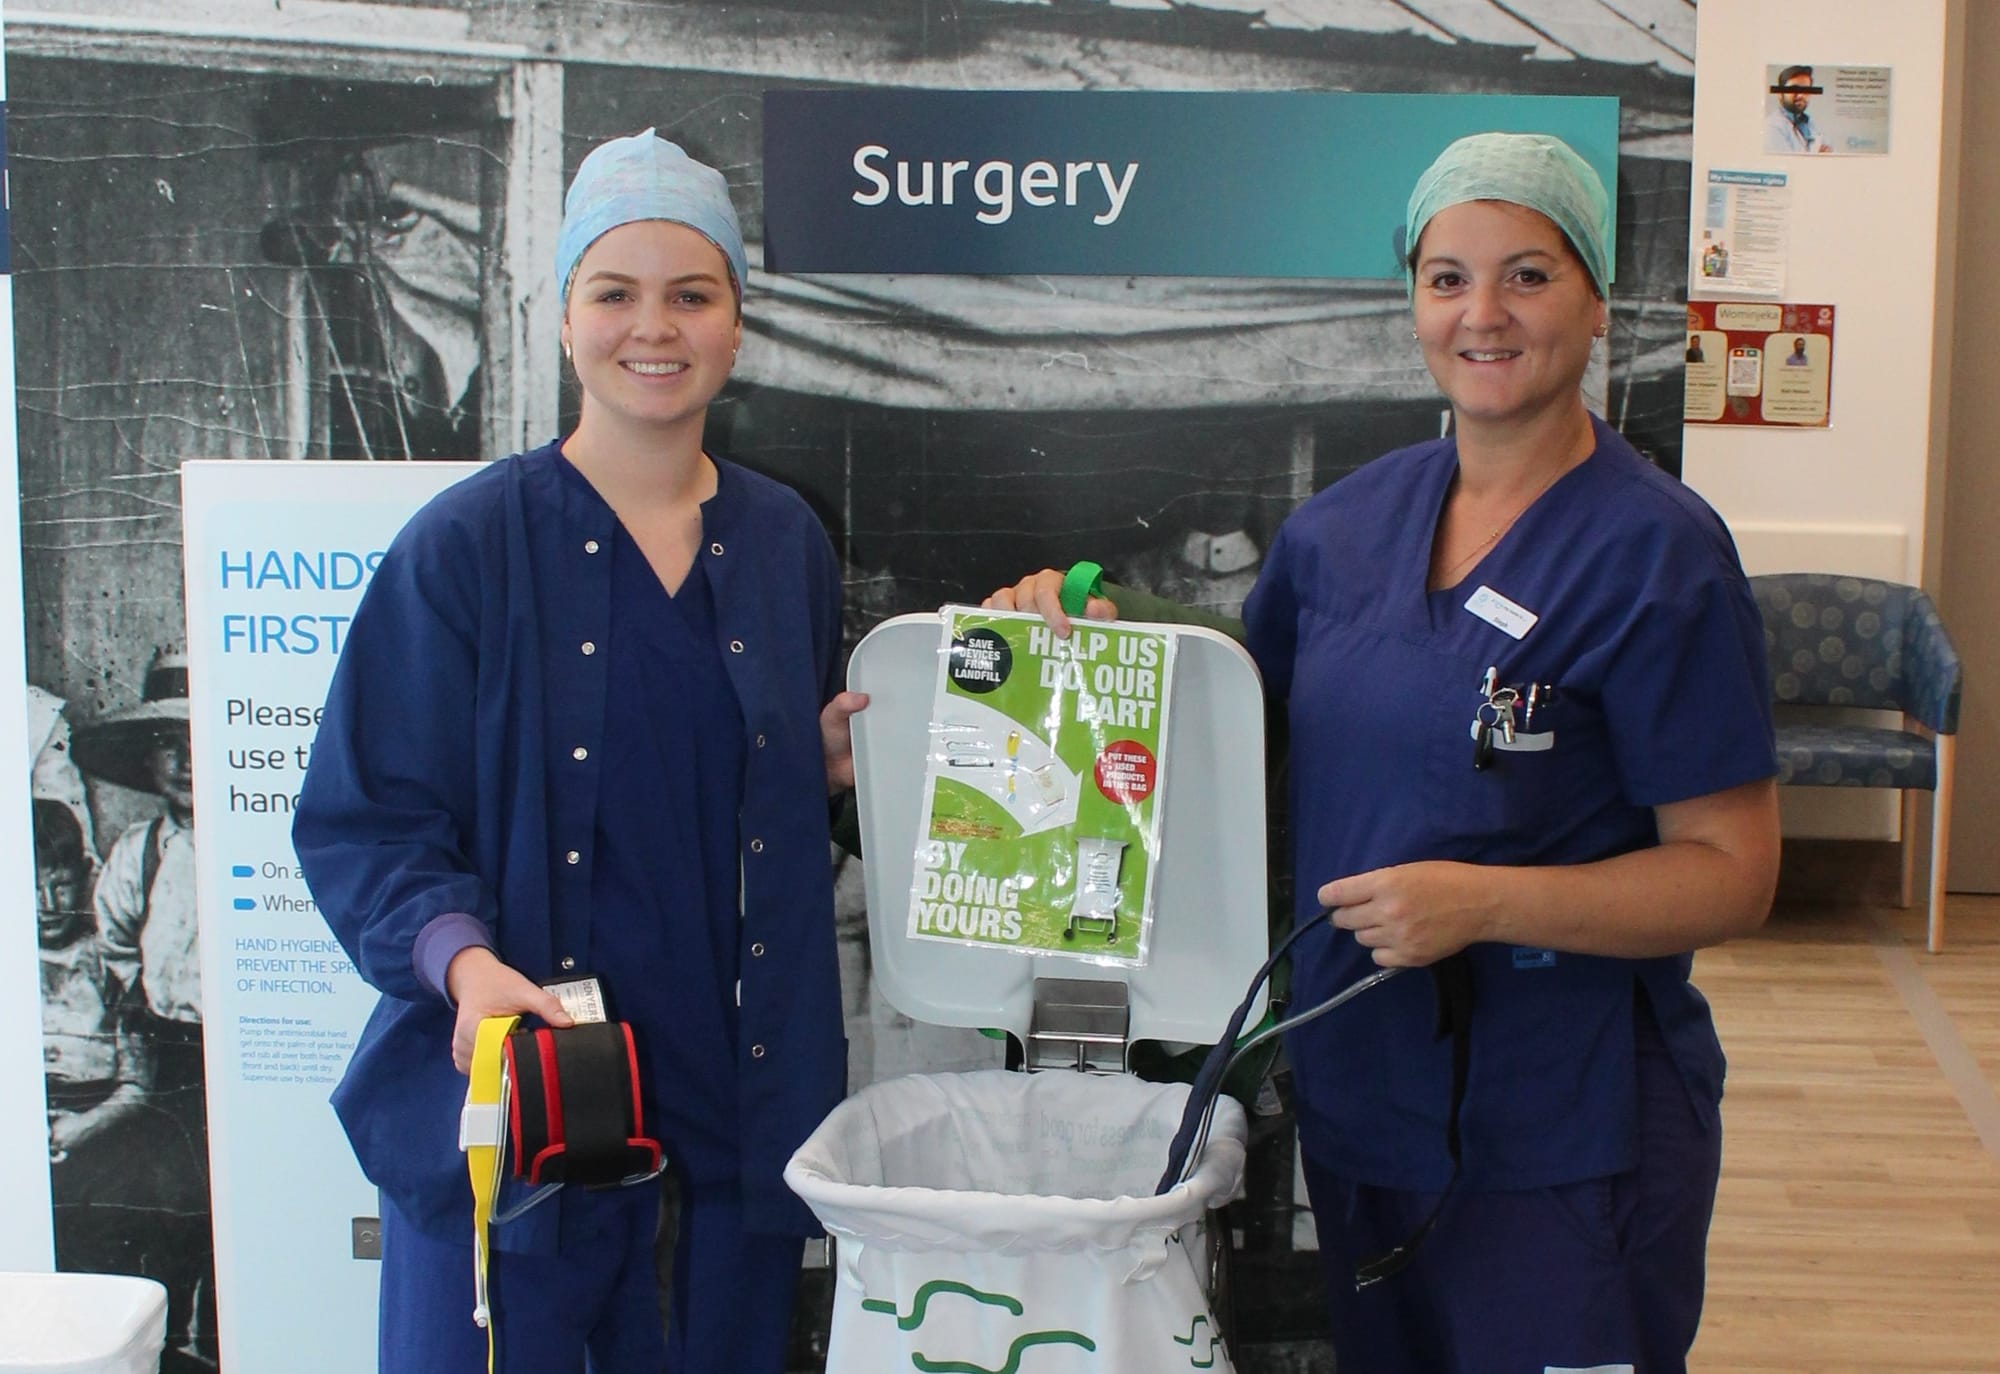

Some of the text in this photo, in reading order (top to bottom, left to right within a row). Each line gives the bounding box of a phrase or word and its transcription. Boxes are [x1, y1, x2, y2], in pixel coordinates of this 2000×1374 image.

[852, 145, 1138, 226] Surgery
[1719, 307, 1779, 321] Wominjeka
[223, 615, 351, 655] FIRST
[968, 638, 994, 650] SAVE
[1029, 626, 1158, 668] HELP US
[959, 648, 1001, 661] DEVICES
[964, 659, 993, 671] FROM
[955, 668, 1001, 682] LANDFILL
[1040, 658, 1156, 700] DO OUR
[1075, 693, 1156, 730] PART
[229, 749, 285, 770] use
[1124, 753, 1147, 763] THESE
[925, 840, 968, 872] BY
[262, 861, 289, 880] On
[920, 870, 1019, 909] DOING
[263, 894, 317, 913] When
[918, 901, 1023, 941] YOURS
[236, 938, 340, 953] HAND HYGIENE
[236, 958, 360, 975] PREVENT THE SPR
[237, 979, 337, 994] OF INFECTION.
[239, 1016, 280, 1025] Directions
[281, 1016, 293, 1025] for
[239, 1027, 347, 1039] Pump the antimicrobial hand
[240, 1040, 252, 1049] gel
[272, 1040, 286, 1048] the
[287, 1040, 306, 1050] palm
[308, 1041, 316, 1049] of
[317, 1042, 334, 1051] your
[241, 1051, 256, 1059] and
[257, 1051, 271, 1059] rub
[271, 1051, 281, 1059] all
[299, 1053, 317, 1061] both
[263, 1063, 279, 1071] and
[301, 1063, 318, 1072] until
[241, 1071, 279, 1083] Supervise
[280, 1075, 293, 1083] use
[294, 1074, 304, 1084] by
